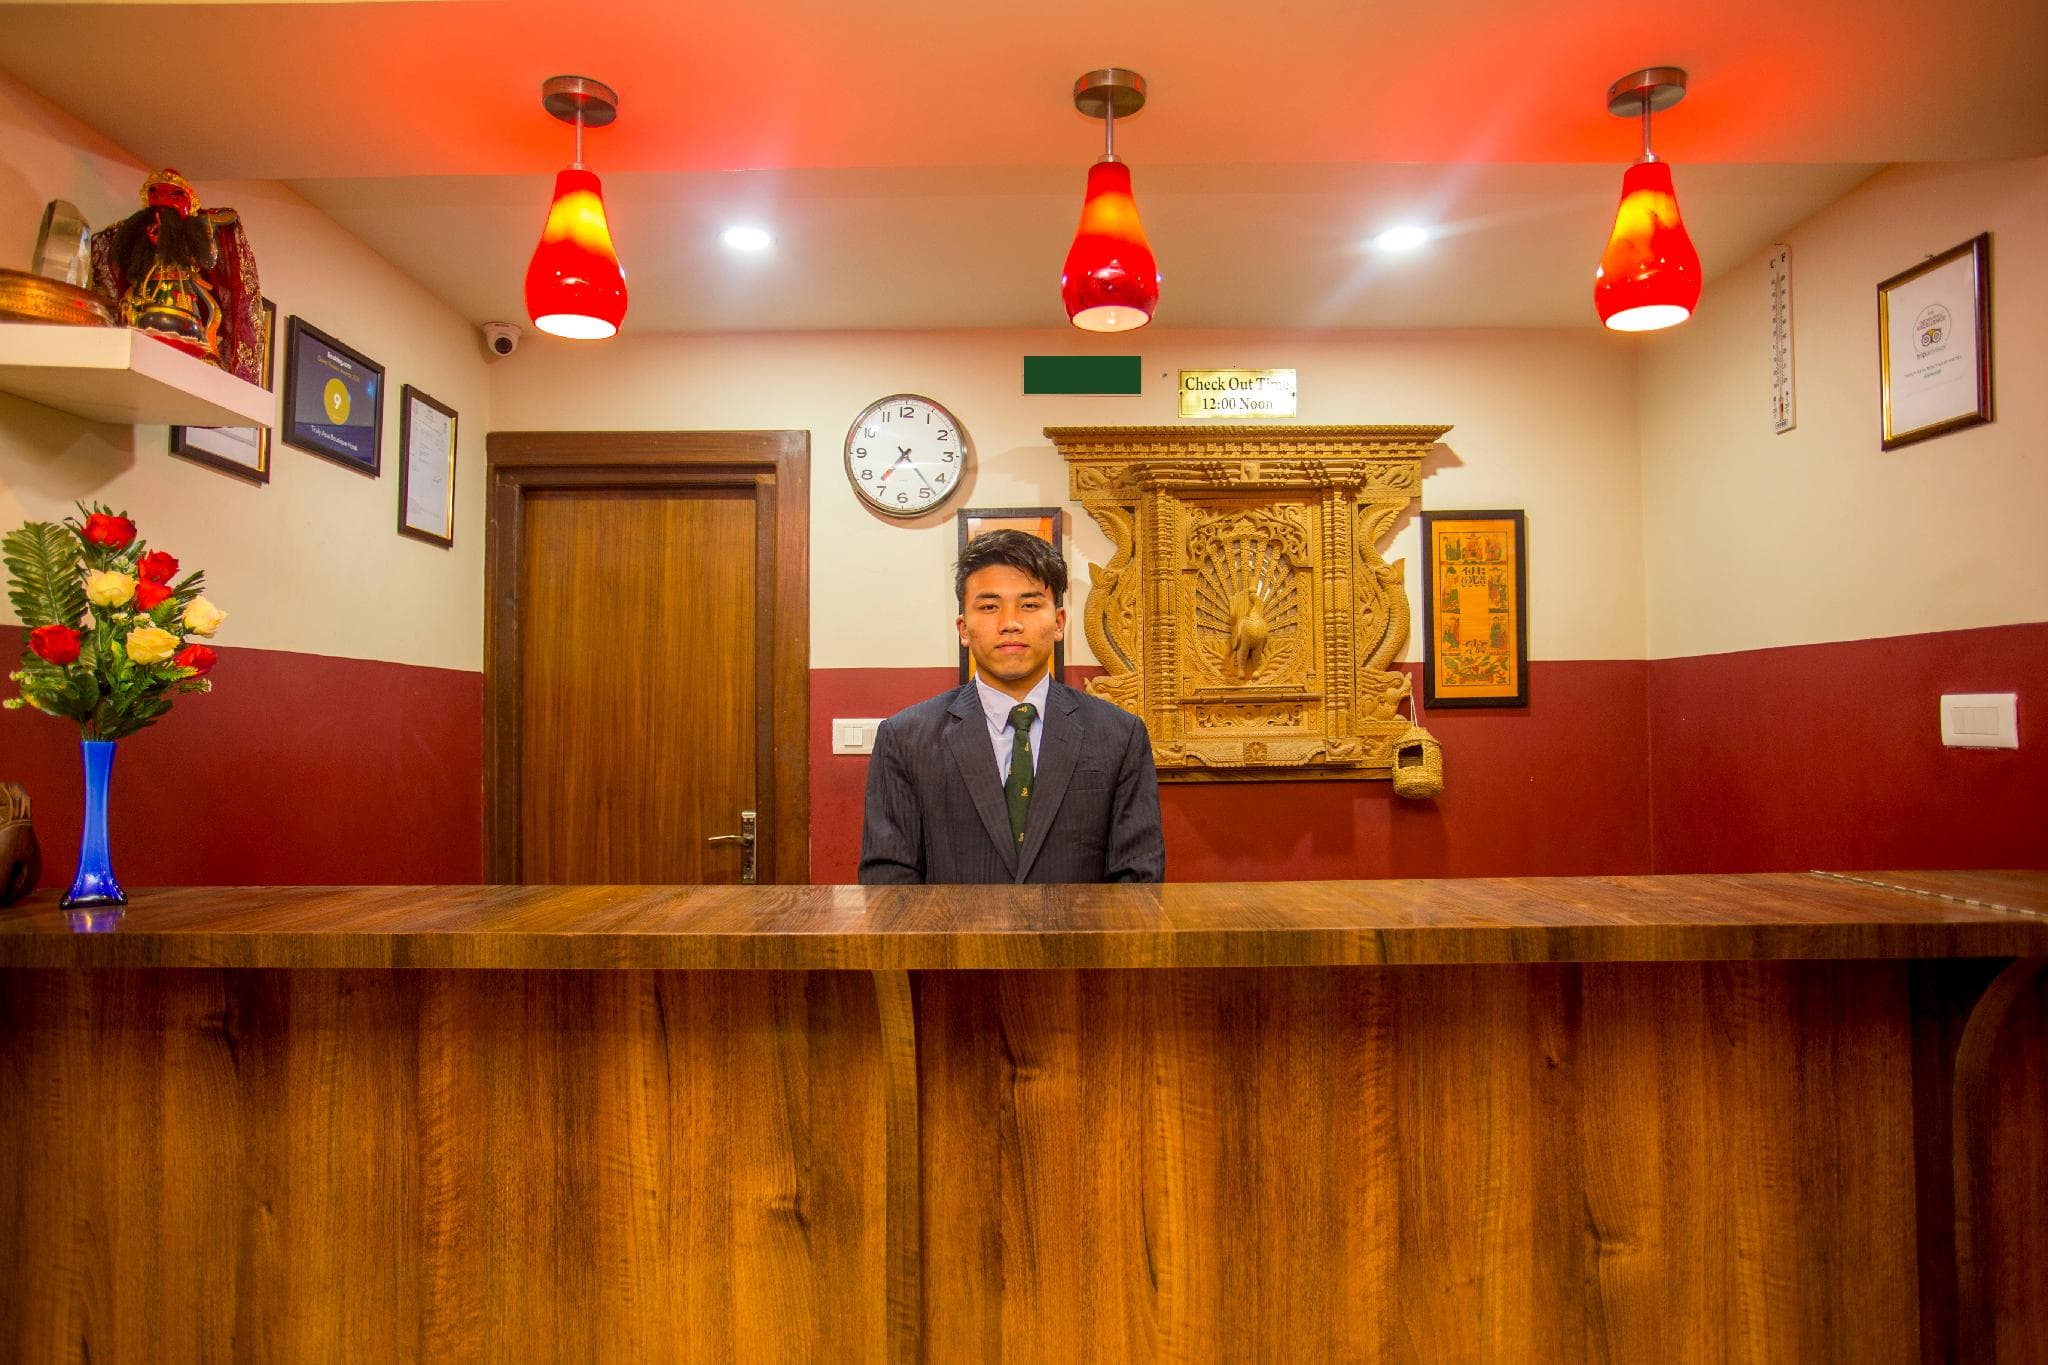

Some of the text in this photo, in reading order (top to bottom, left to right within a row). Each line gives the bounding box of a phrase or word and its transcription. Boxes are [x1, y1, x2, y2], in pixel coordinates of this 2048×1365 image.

[1185, 377, 1226, 390] Check
[1228, 377, 1253, 390] Out
[333, 393, 341, 410] 9
[1203, 397, 1273, 410] 12:00 Noon
[882, 412, 891, 423] 11
[900, 406, 915, 418] 12
[926, 413, 931, 424] 1
[864, 428, 876, 438] 10
[937, 430, 948, 441] 2
[856, 448, 867, 458] 9
[942, 451, 954, 463] 3
[861, 469, 873, 480] 8
[935, 472, 946, 484] 4
[876, 485, 887, 497] 7
[919, 487, 931, 499] 5
[897, 492, 909, 504] 6
